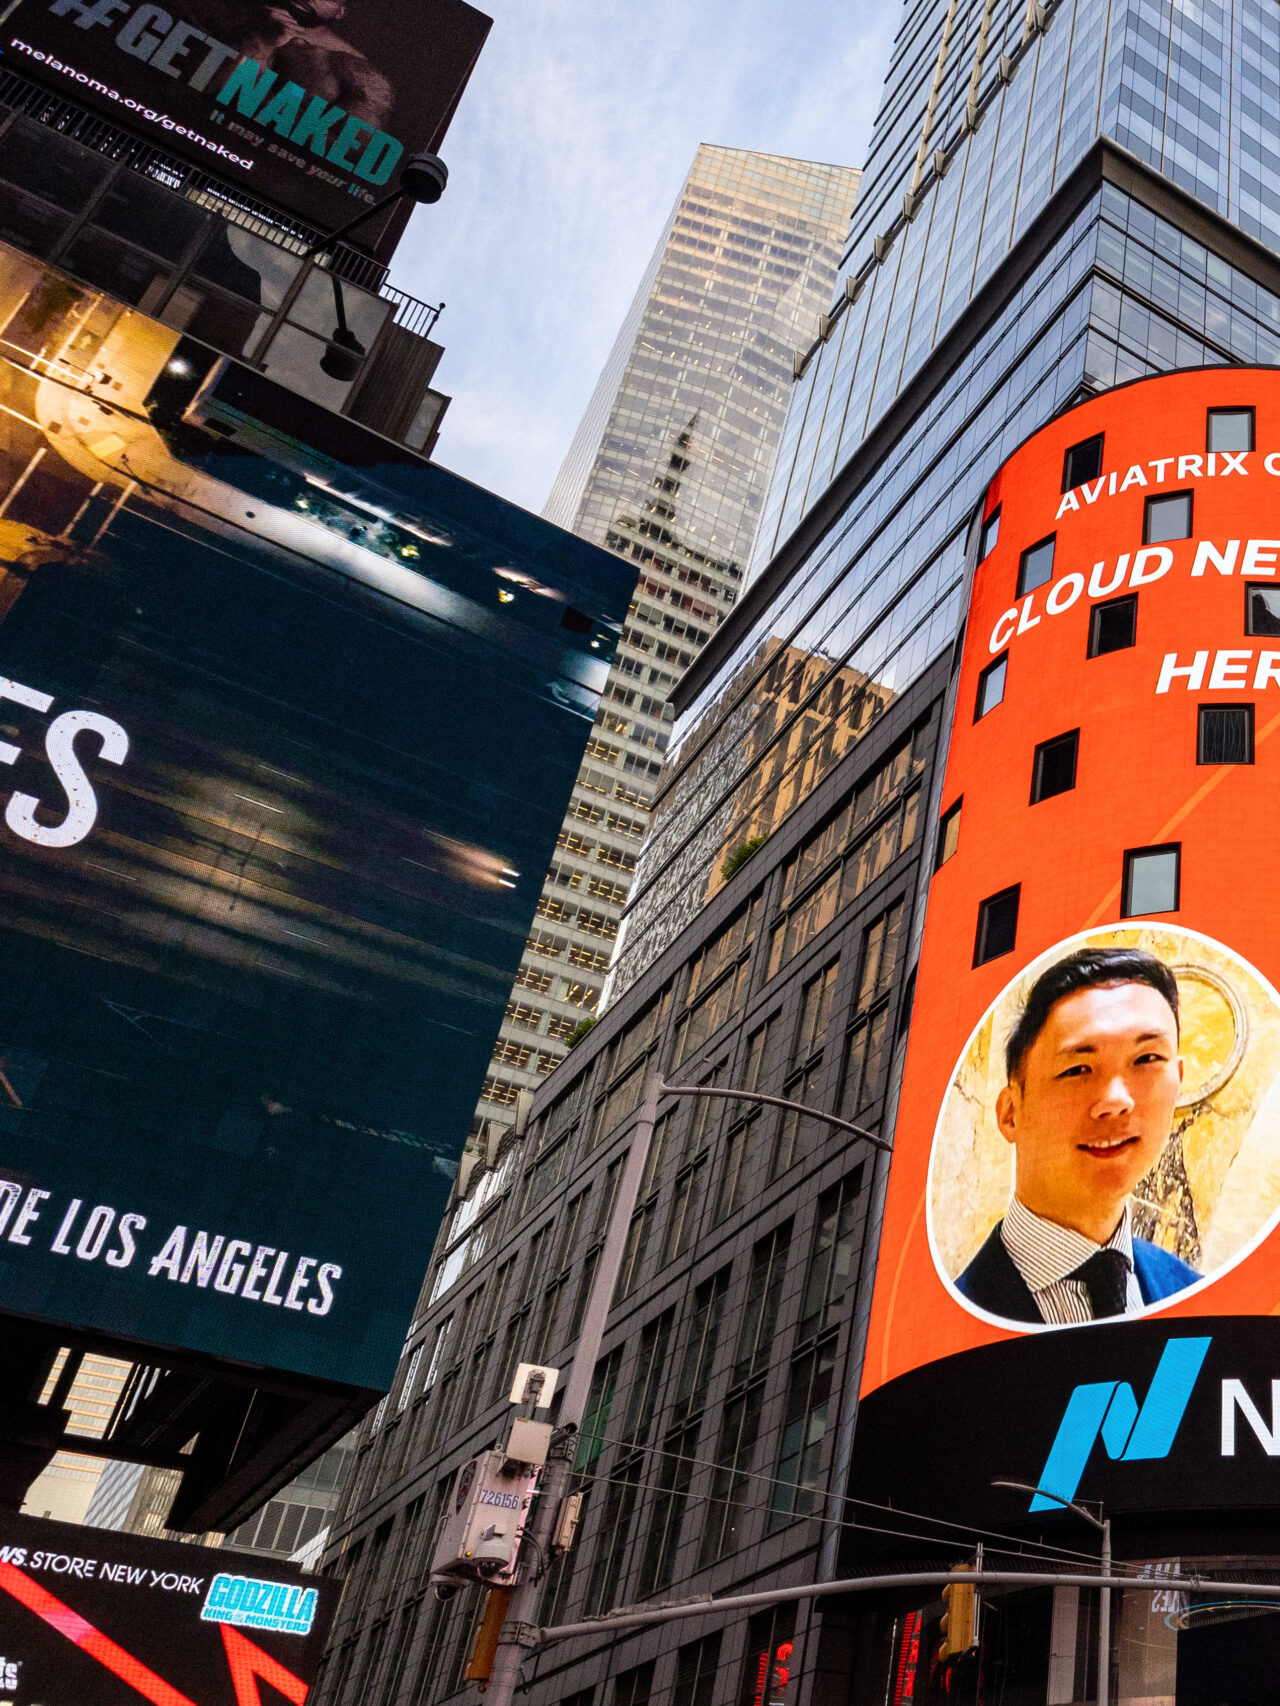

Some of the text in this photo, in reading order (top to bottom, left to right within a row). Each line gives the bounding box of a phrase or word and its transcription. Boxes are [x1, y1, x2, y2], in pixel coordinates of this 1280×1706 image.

[10, 38, 254, 170] melanoma.org/getnaked
[227, 120, 264, 147] may
[268, 143, 306, 169] save
[308, 165, 347, 188] your
[1054, 452, 1250, 521] AVIATRIX
[988, 546, 1173, 654] CLOUD
[51, 1199, 147, 1268] LOS
[147, 1225, 342, 1316] ANGELES
[481, 1489, 519, 1509] 726156
[30, 1551, 97, 1578] STORE
[99, 1563, 148, 1586] NEW
[149, 1570, 204, 1594] YORK
[207, 1576, 316, 1622] GODZILLA
[203, 1607, 233, 1621] KING
[244, 1614, 309, 1633] MONSTERS
